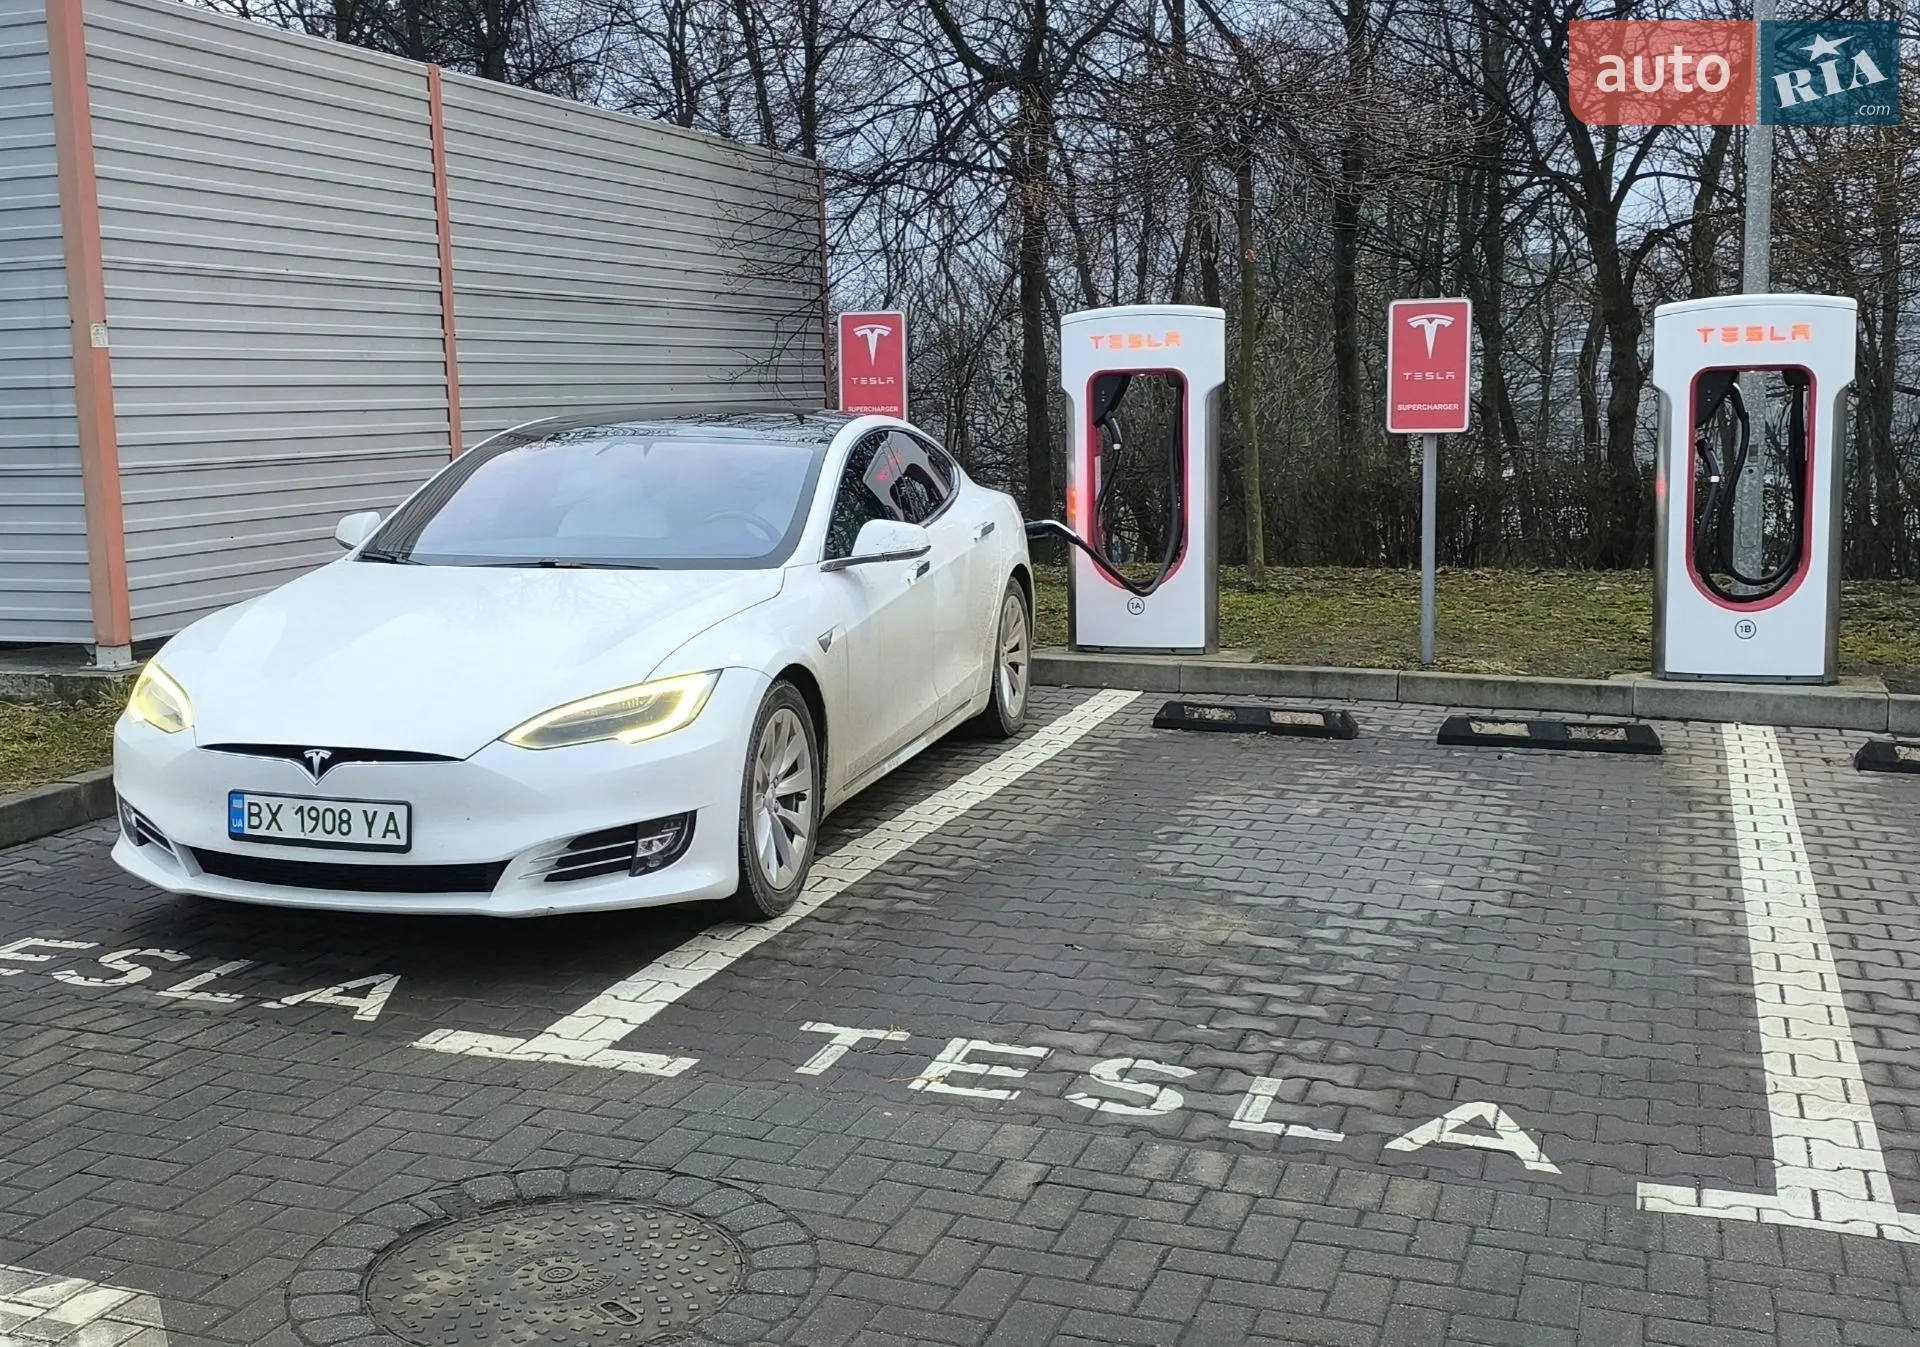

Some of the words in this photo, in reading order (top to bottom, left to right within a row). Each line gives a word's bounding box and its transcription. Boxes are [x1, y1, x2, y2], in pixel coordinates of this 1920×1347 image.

[1696, 323, 1813, 344] TESLA
[1090, 330, 1183, 351] TESLA
[851, 377, 895, 385] TESLA
[1402, 371, 1456, 381] TESLA
[1397, 403, 1459, 411] SUPERCHARGER
[1130, 601, 1142, 610] 1A
[1739, 625, 1752, 634] 1B
[232, 818, 243, 828] UA
[247, 801, 283, 832] BX
[293, 804, 352, 837] 1908
[362, 809, 401, 840] YA
[793, 1019, 1563, 1175] TESLA
